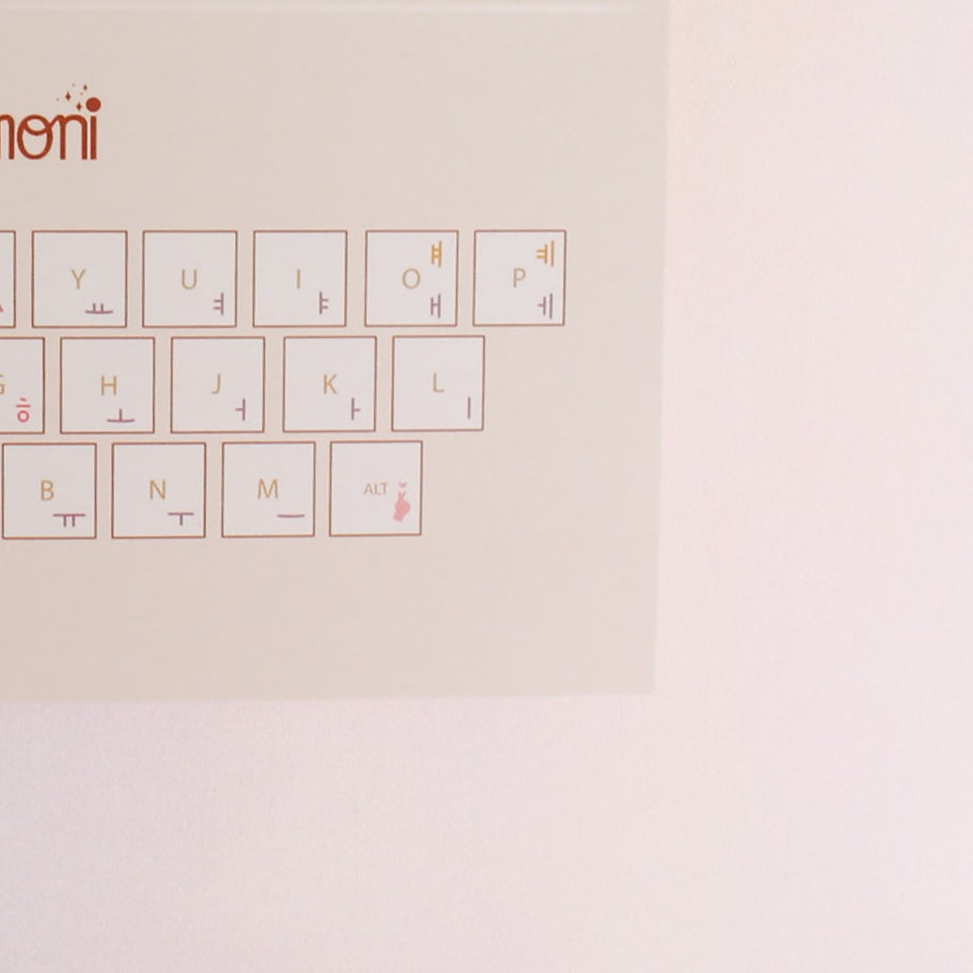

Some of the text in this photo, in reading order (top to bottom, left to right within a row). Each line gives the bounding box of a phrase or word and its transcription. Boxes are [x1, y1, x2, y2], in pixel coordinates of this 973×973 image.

[71, 269, 86, 290] Y
[182, 269, 197, 290] U
[402, 268, 421, 289] O
[513, 267, 526, 288] P
[101, 375, 117, 396] H
[212, 373, 221, 395] J
[323, 374, 337, 394] K
[433, 372, 445, 393] L
[41, 480, 54, 501] B
[150, 480, 166, 500] N
[258, 478, 278, 499] M
[363, 482, 389, 496] ALT
